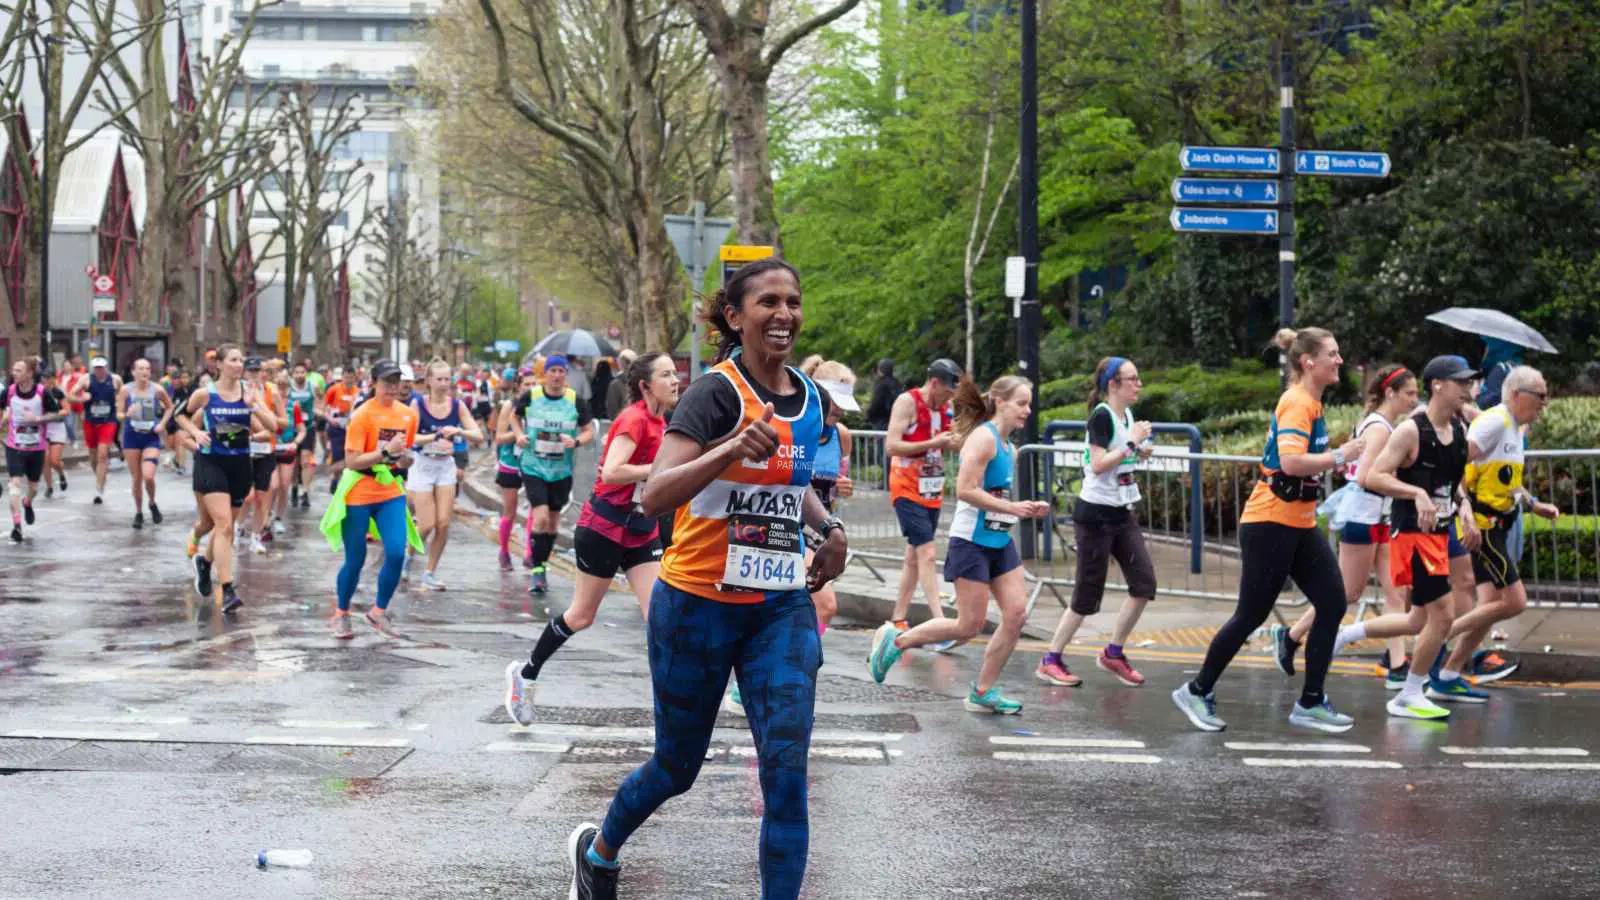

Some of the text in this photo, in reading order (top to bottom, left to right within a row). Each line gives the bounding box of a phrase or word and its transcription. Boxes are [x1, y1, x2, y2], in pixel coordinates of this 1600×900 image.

[1237, 154, 1265, 165] House
[1331, 157, 1379, 170] South Quay
[777, 444, 806, 459] CURE
[740, 555, 796, 584] 51644
